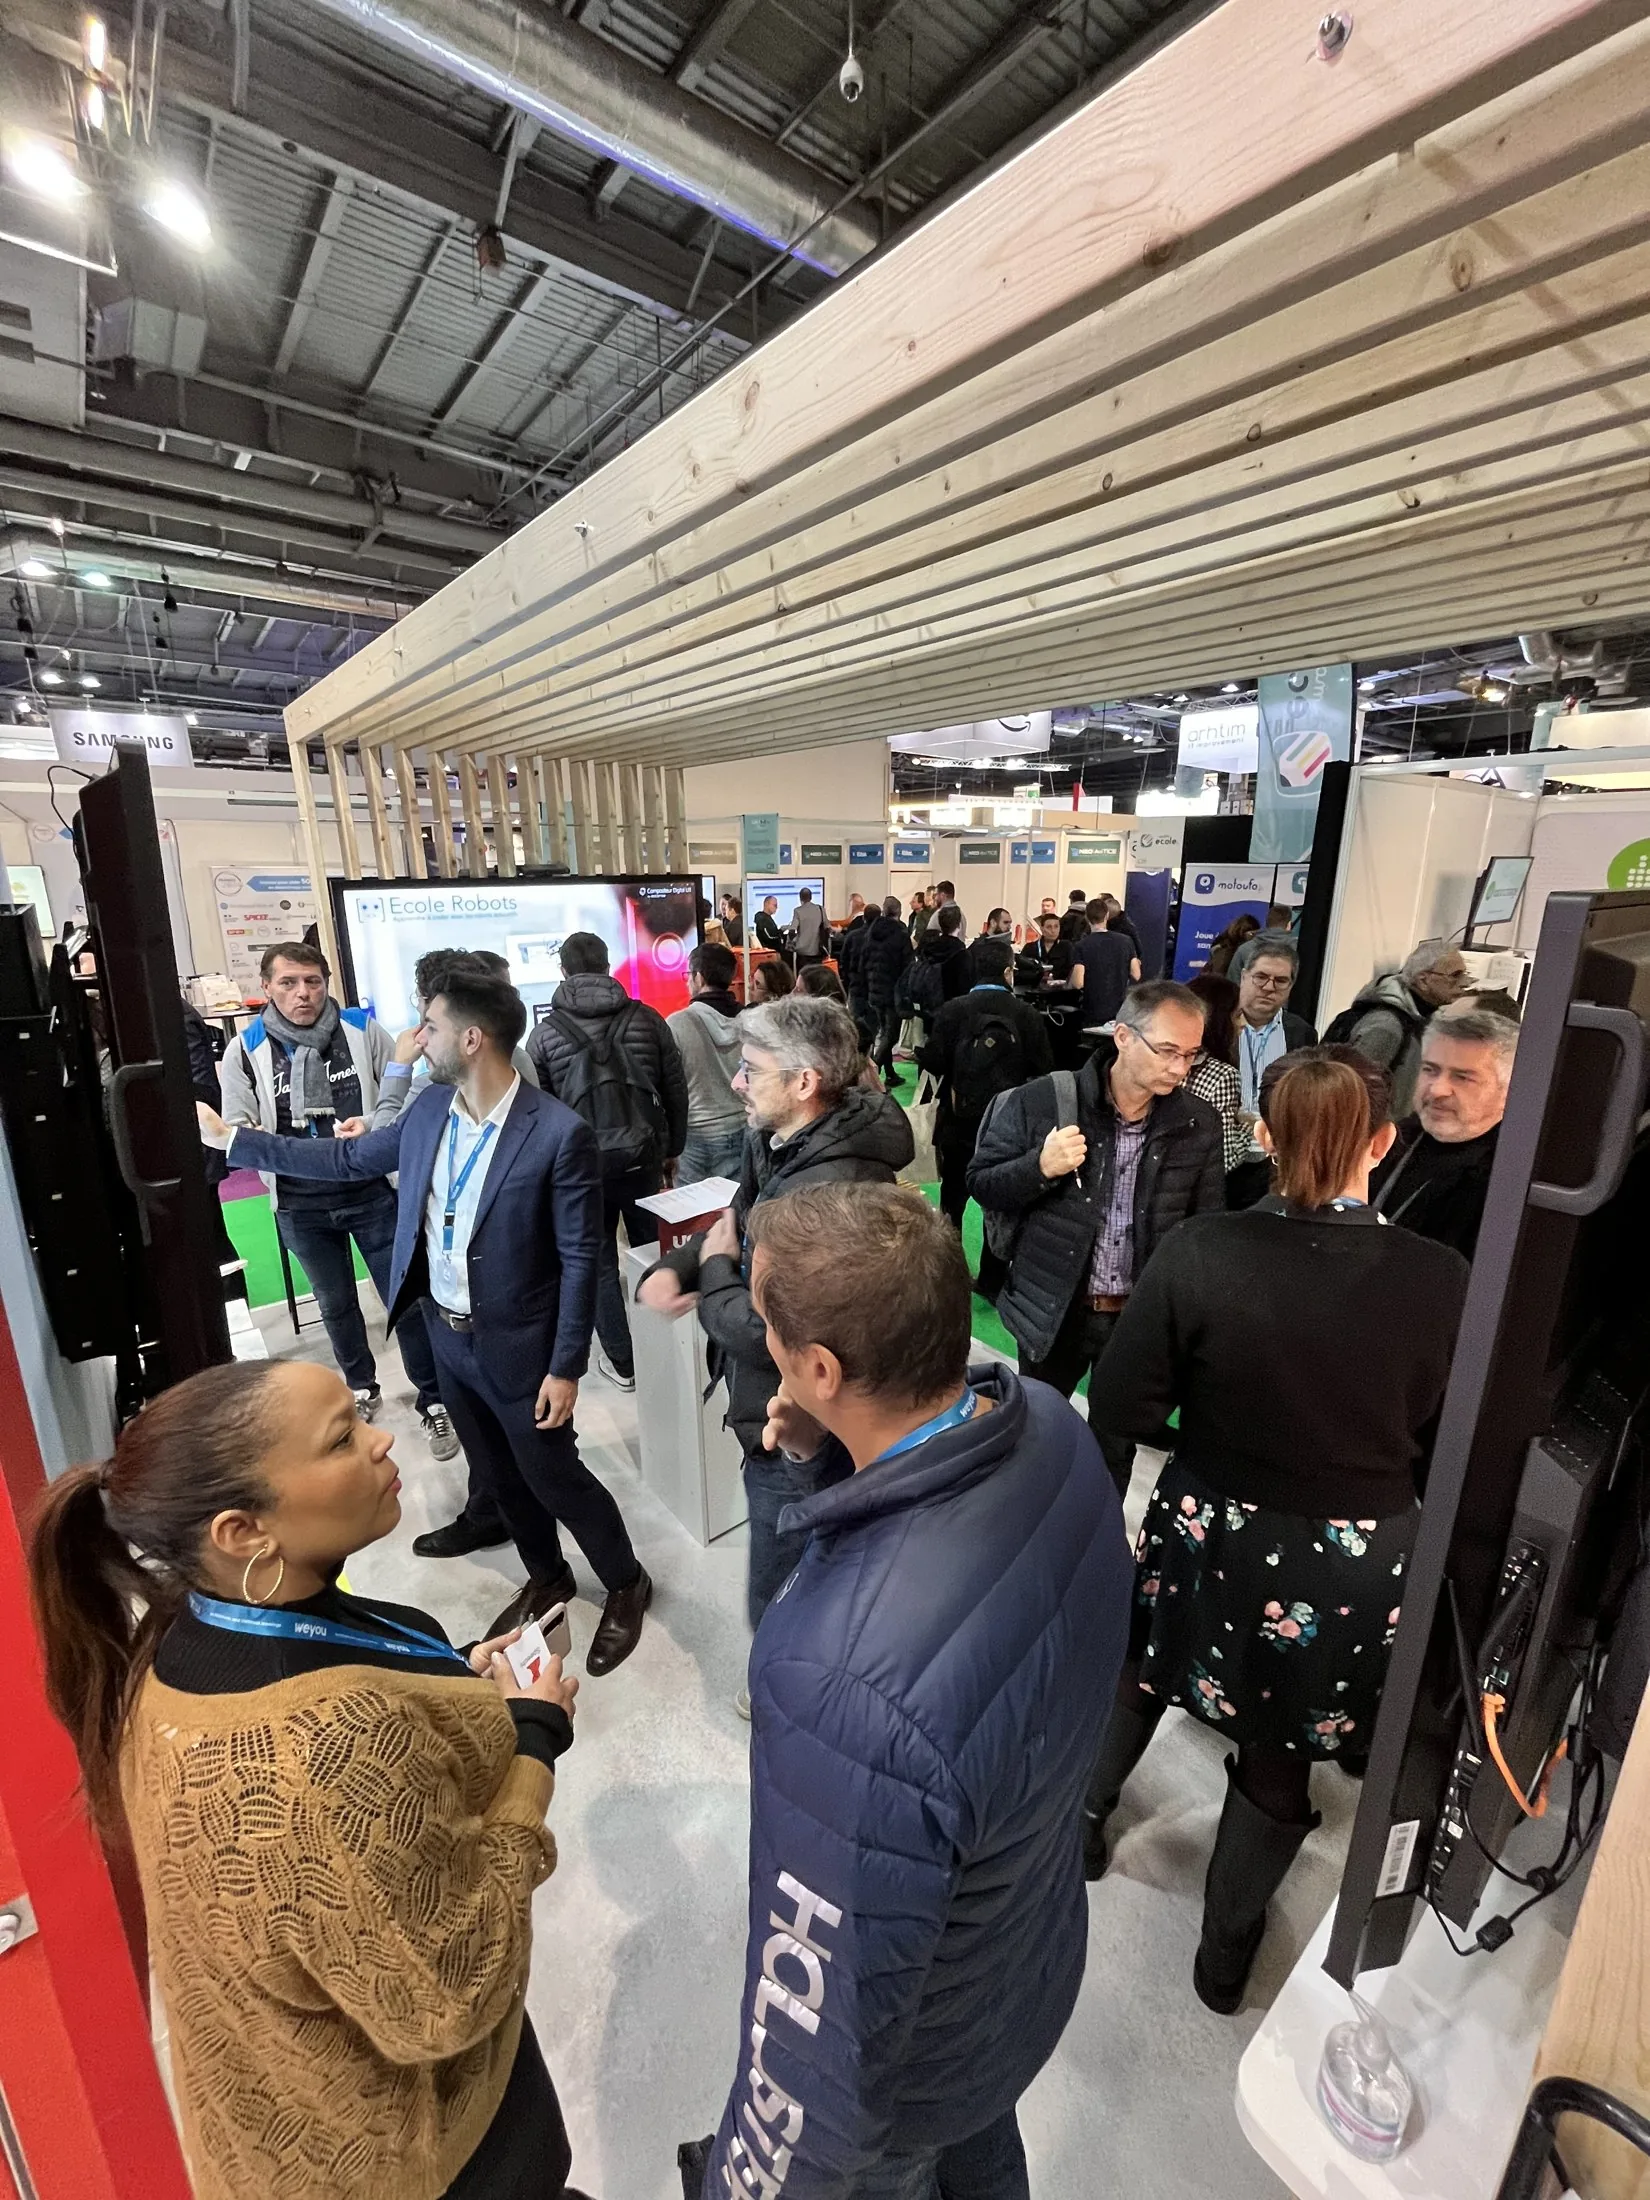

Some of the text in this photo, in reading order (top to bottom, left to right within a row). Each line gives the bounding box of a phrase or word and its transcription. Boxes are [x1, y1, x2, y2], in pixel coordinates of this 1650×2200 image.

[72, 731, 174, 750] SAMNG
[1155, 836, 1177, 845] ecole
[389, 893, 518, 915] Ecole Robots
[1194, 930, 1214, 940] Joue
[293, 1621, 328, 1638] weyou
